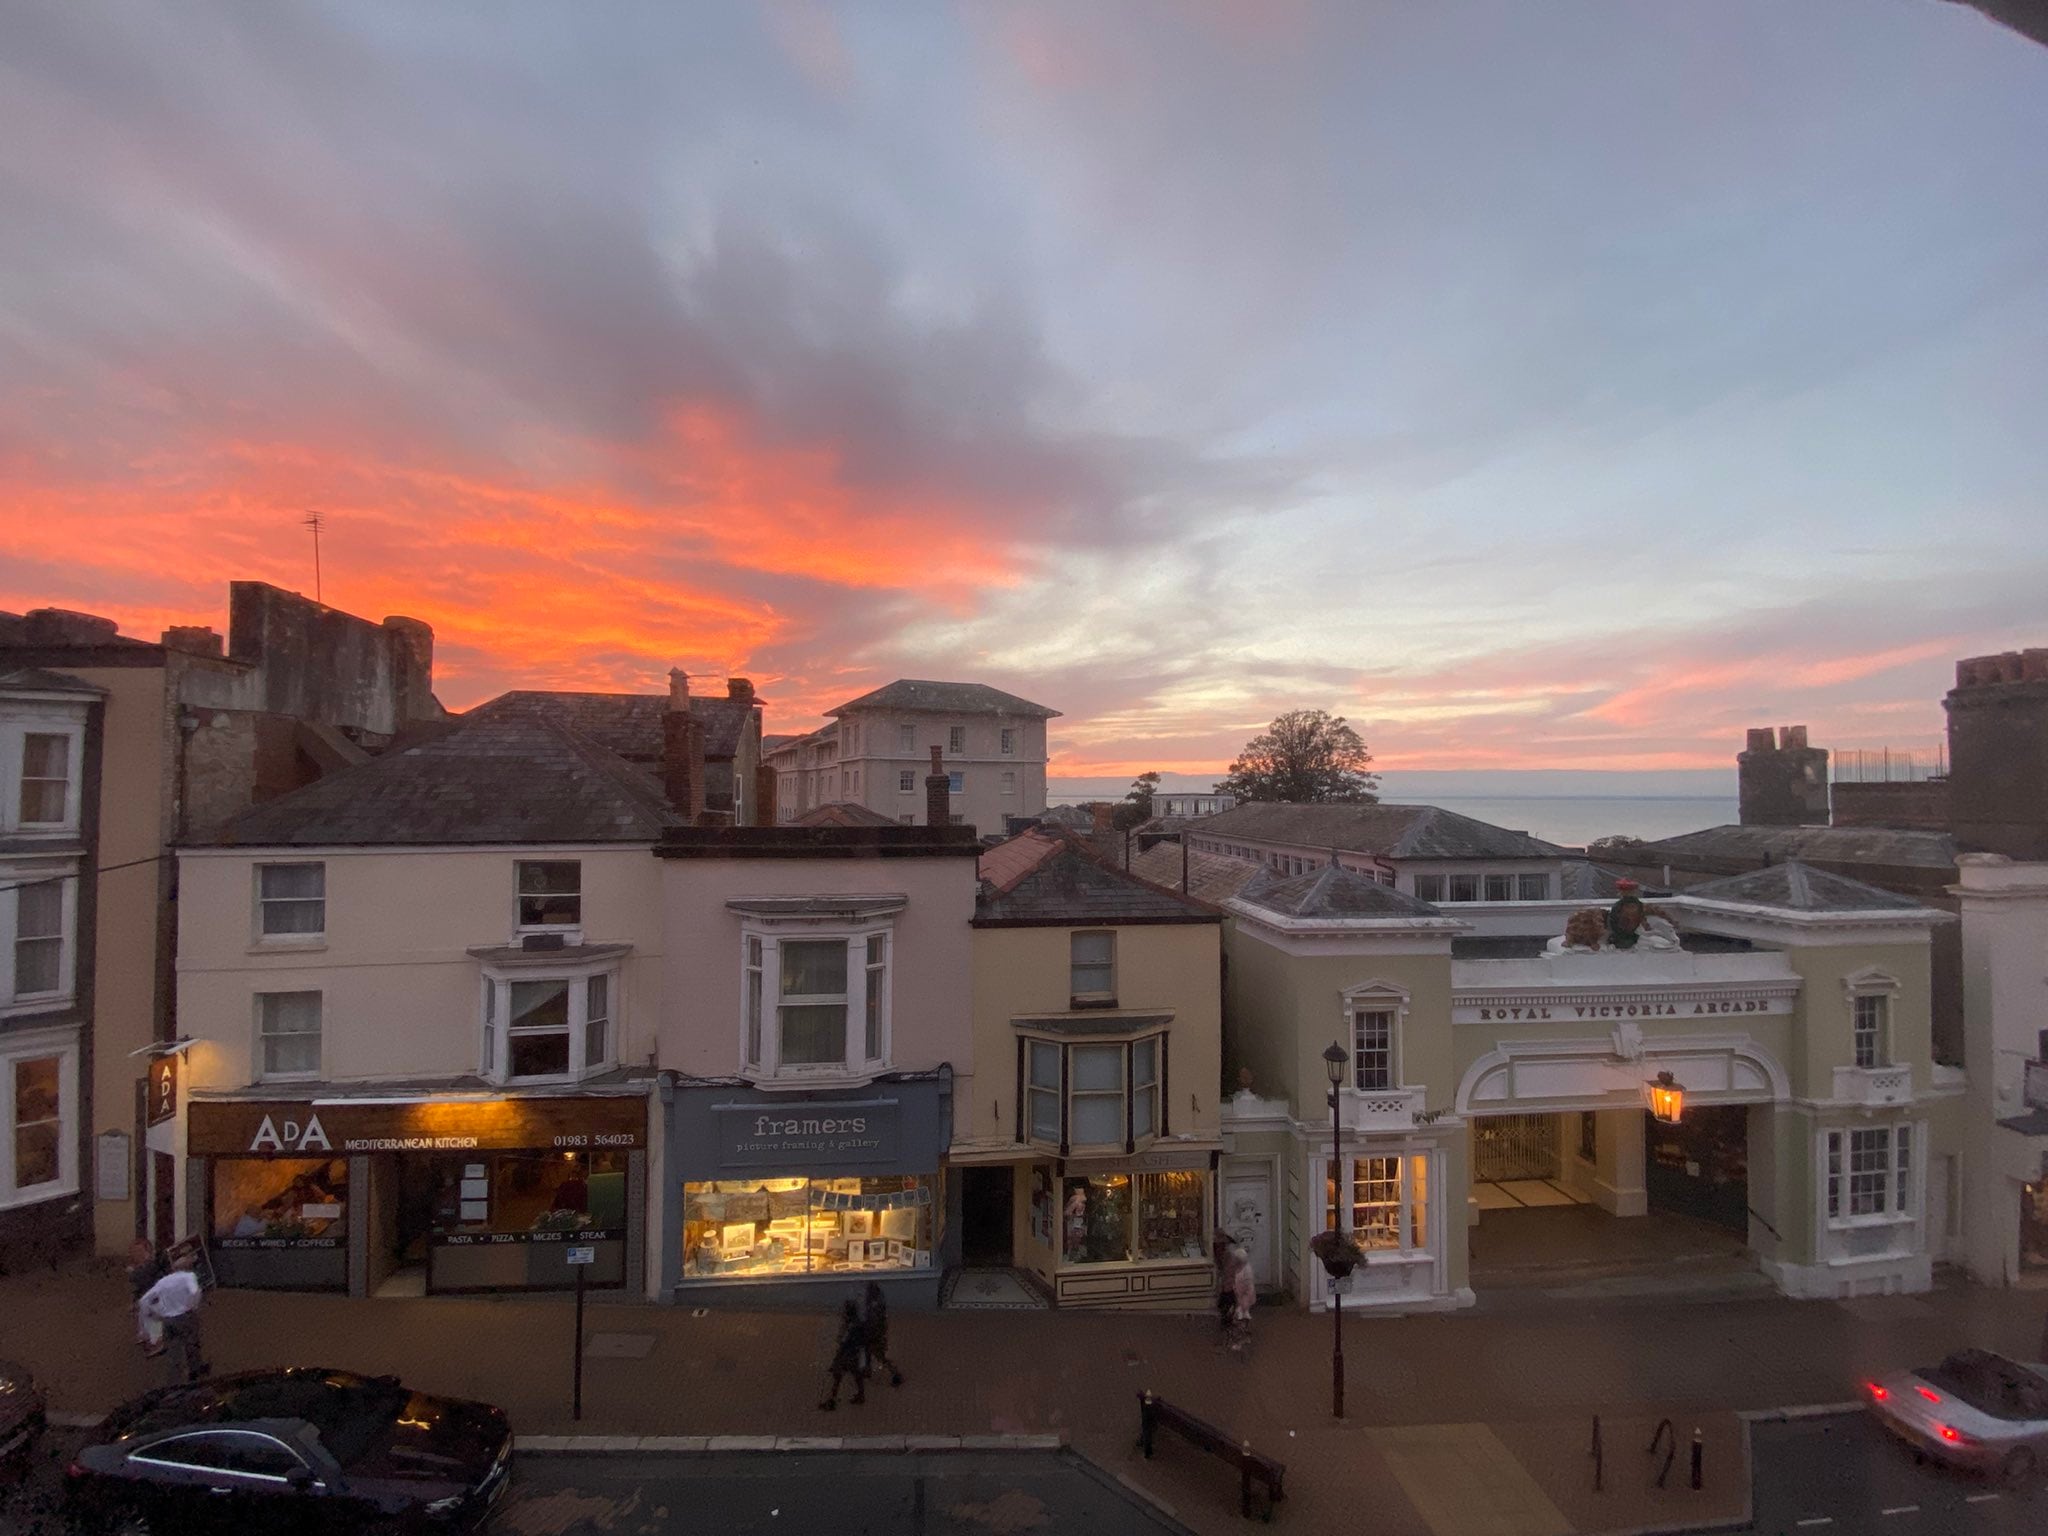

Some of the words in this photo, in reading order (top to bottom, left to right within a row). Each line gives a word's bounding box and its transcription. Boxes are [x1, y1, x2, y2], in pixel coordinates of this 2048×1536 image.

[1481, 1008, 1551, 1020] ROYAL
[1575, 1004, 1676, 1018] VICTORIA
[1693, 1001, 1769, 1014] ARCADE
[161, 1065, 172, 1113] ADA
[754, 1115, 866, 1136] framers
[345, 1137, 432, 1150] MEDITERRANEAN
[435, 1136, 478, 1148] KITCHEN
[554, 1135, 588, 1146] 01983
[594, 1134, 635, 1145] 564023
[736, 1142, 778, 1153] picture
[782, 1140, 825, 1151] framing
[838, 1138, 880, 1150] gallery
[297, 1239, 336, 1247] COFFEES
[448, 1235, 473, 1244] PASTA
[491, 1234, 515, 1242] PIZZA
[533, 1232, 561, 1241] MEZES
[580, 1231, 606, 1239] STEAK
